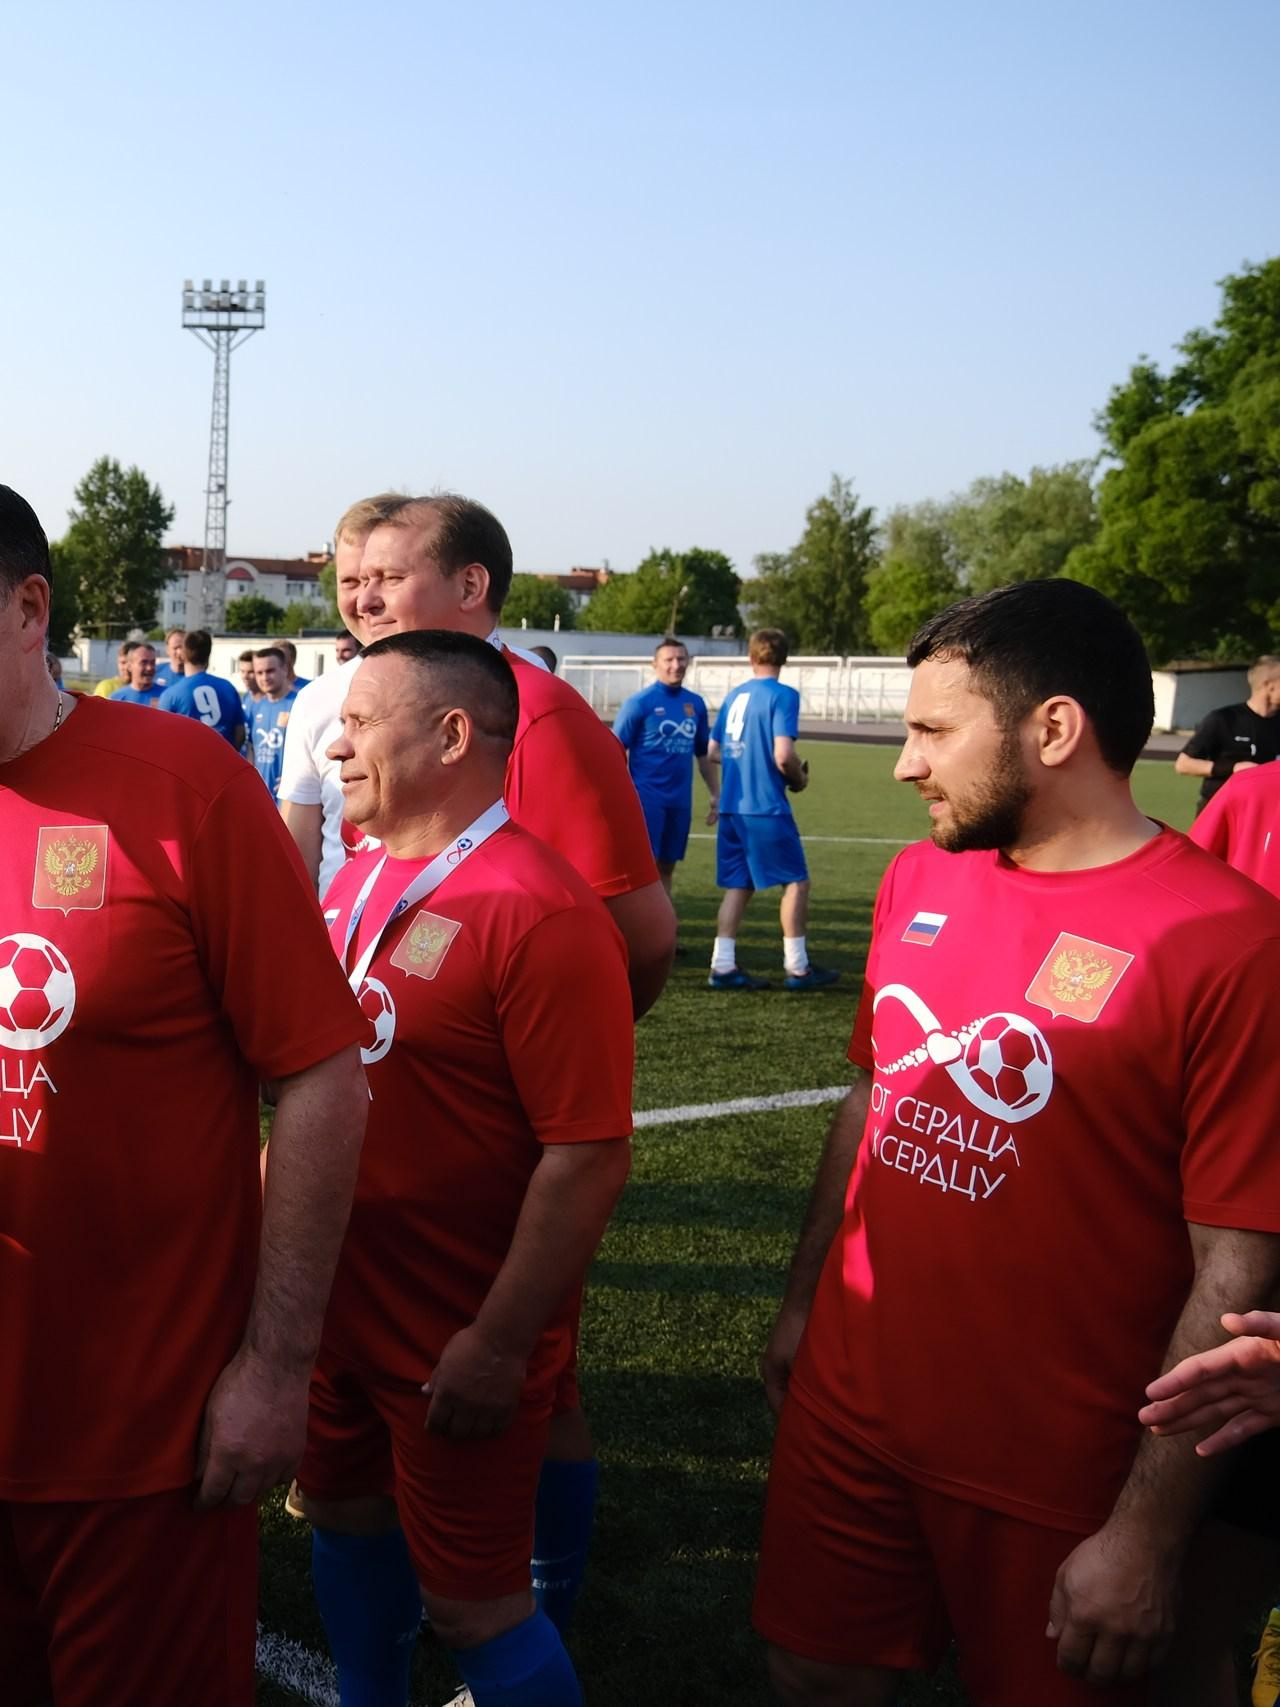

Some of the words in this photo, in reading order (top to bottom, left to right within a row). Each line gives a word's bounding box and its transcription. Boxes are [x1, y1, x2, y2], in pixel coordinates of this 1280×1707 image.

[193, 685, 222, 727] 9
[726, 692, 750, 741] 4
[871, 1081, 892, 1117] ОТ
[894, 1096, 1022, 1168] СЕРДЦА
[871, 1125, 880, 1160] К
[880, 1135, 1006, 1201] СЕРДЦУ
[531, 1577, 571, 1590] ENIT
